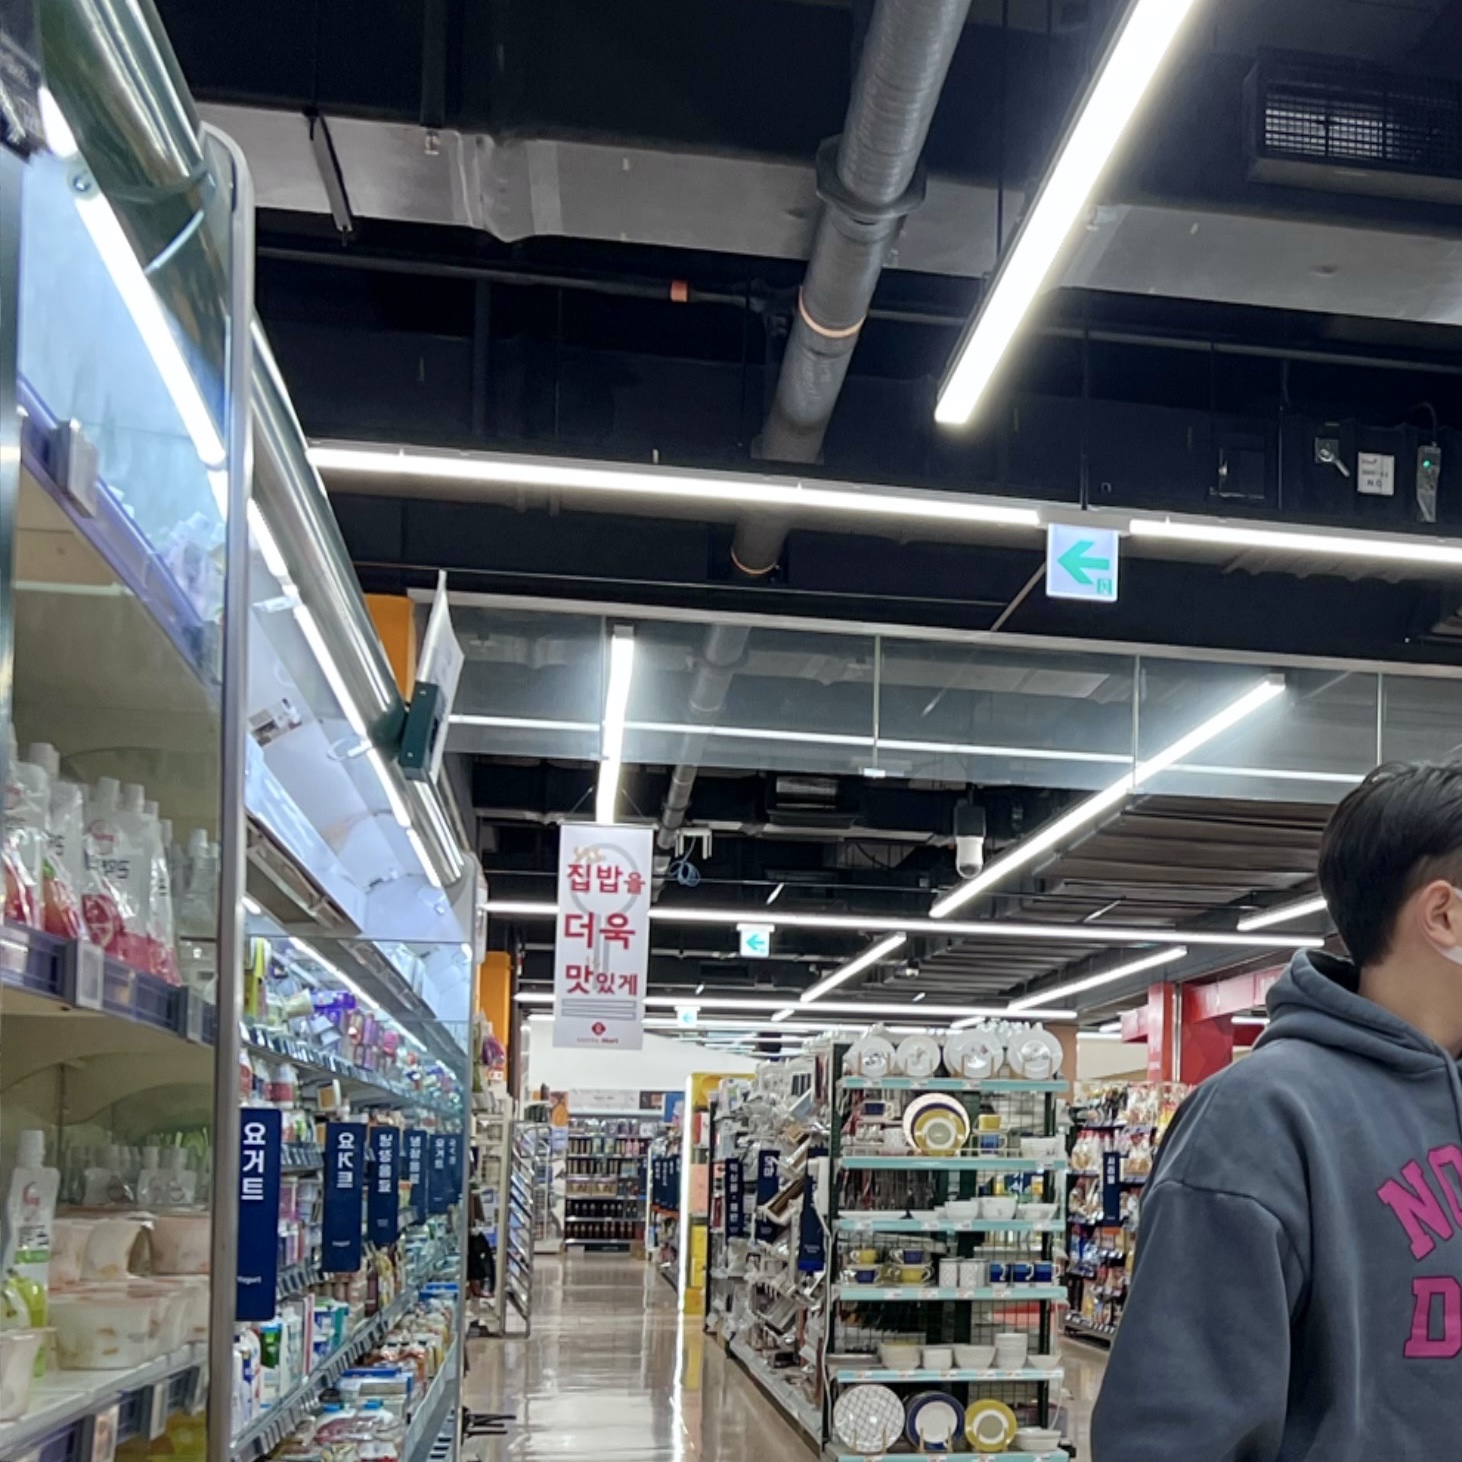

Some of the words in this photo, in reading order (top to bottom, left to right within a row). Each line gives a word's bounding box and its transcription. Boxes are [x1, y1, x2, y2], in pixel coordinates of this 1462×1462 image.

[567, 863, 646, 895] 집밥을
[564, 912, 636, 950] 더욱
[565, 964, 638, 996] 맛있게
[241, 1121, 266, 1201] 요거트
